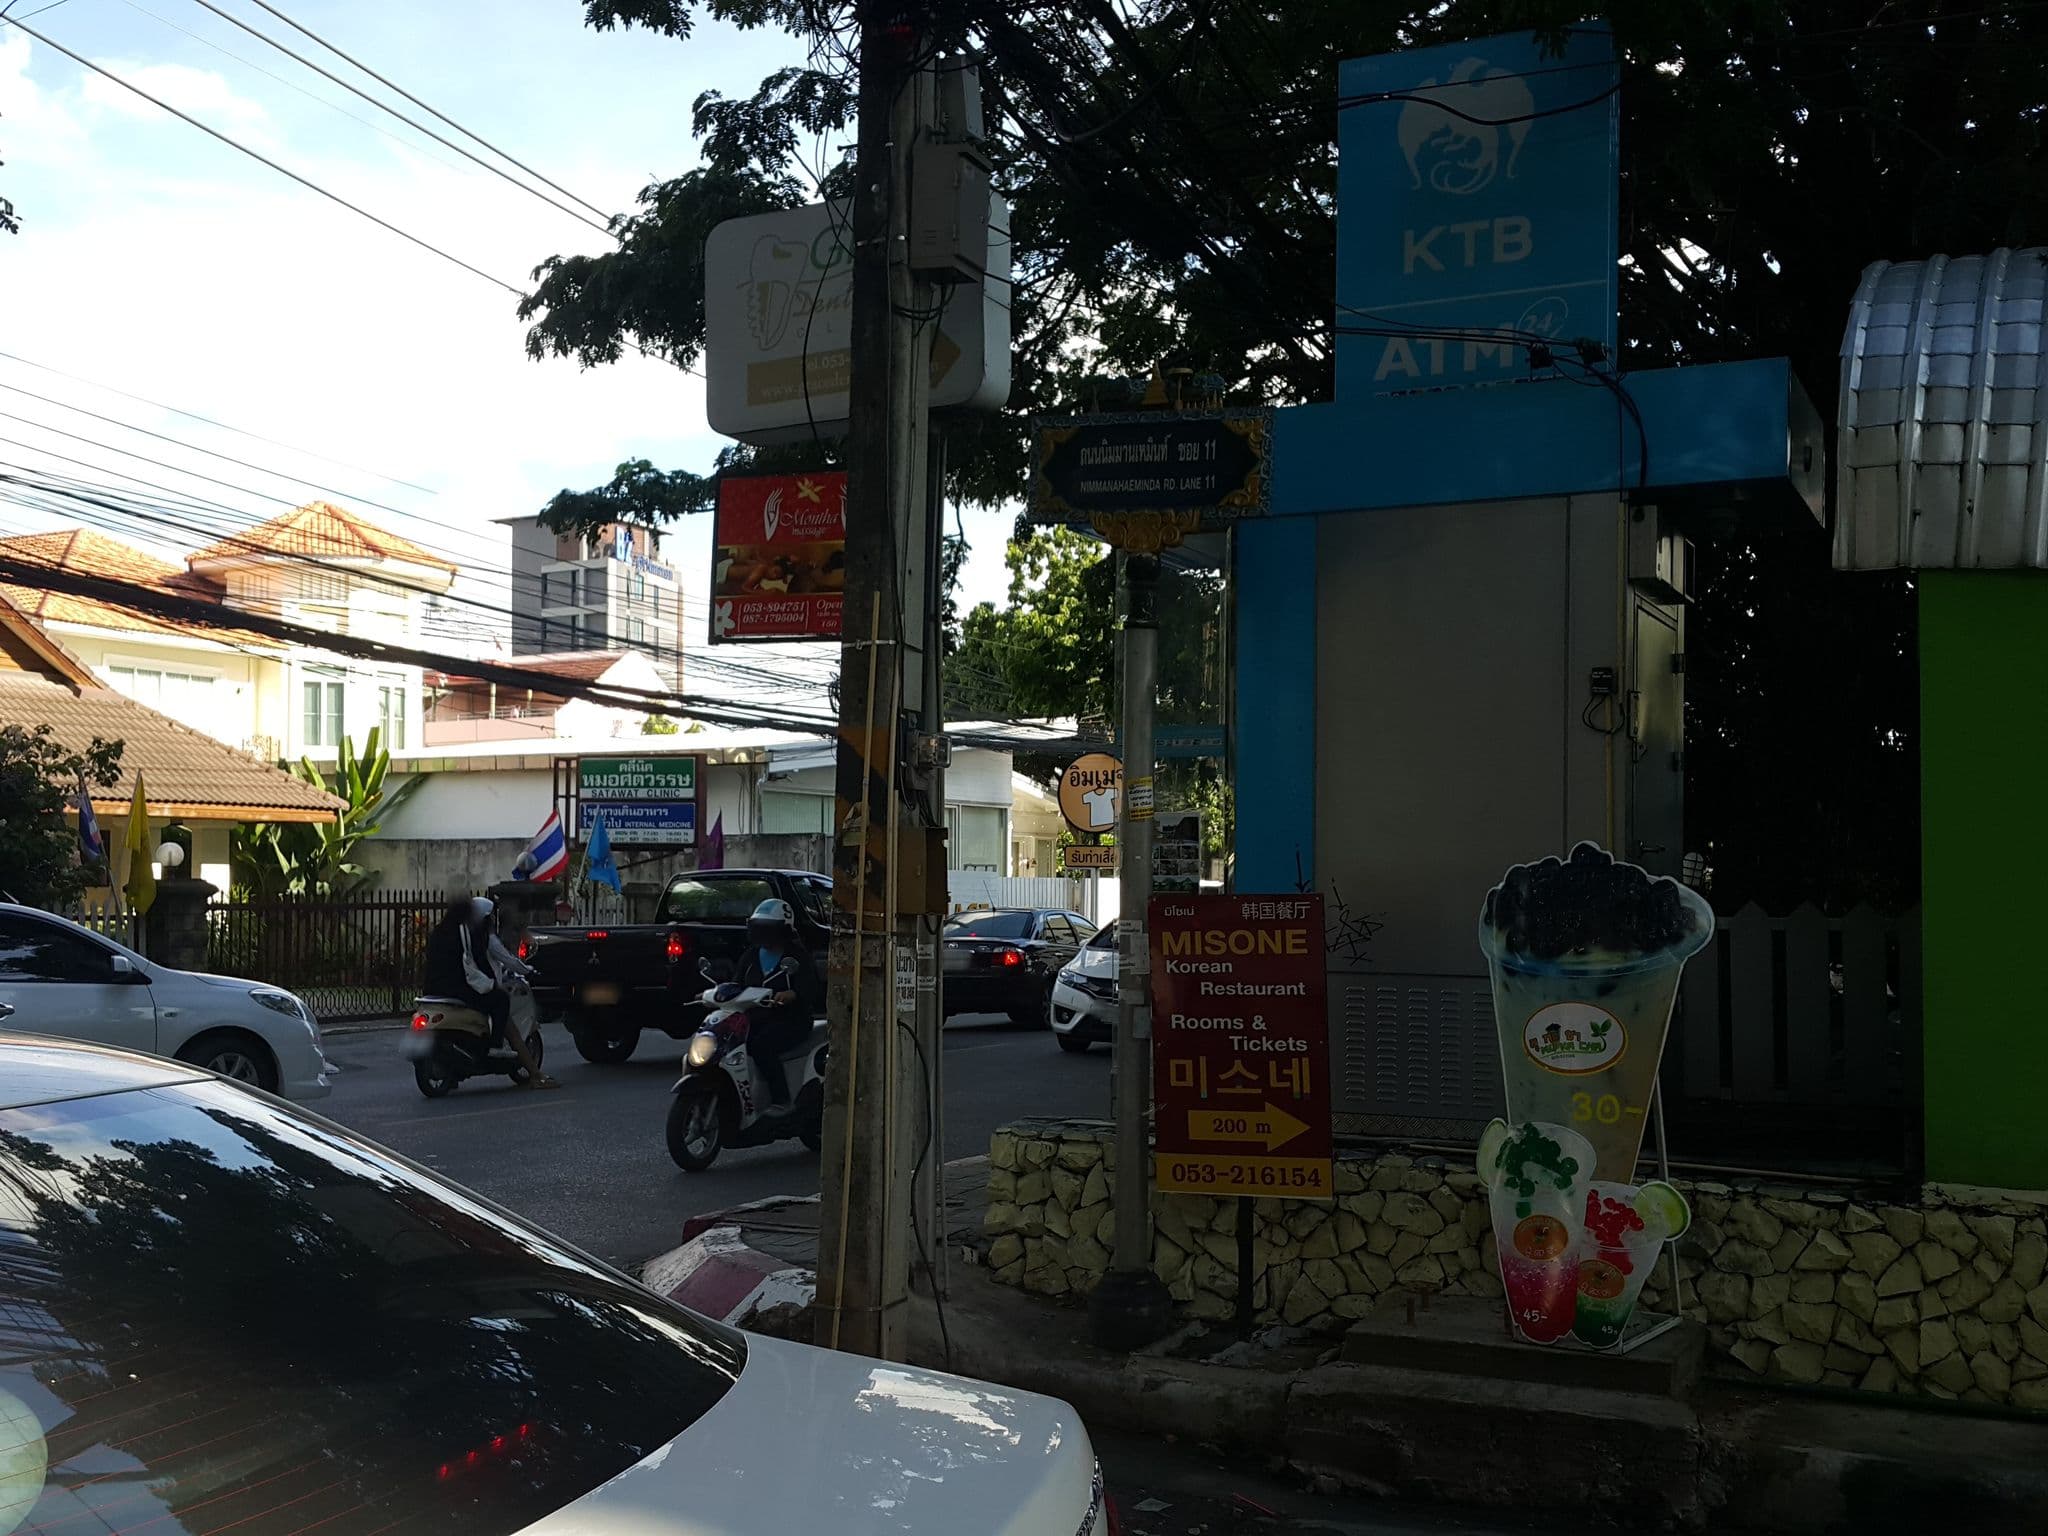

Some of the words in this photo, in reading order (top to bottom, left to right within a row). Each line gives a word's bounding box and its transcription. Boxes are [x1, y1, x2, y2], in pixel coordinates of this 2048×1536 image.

[1402, 215, 1533, 275] KTB
[1373, 321, 1514, 382] ATM
[1523, 311, 1553, 334] 24
[1178, 442, 1200, 462] ซอย
[1204, 440, 1217, 461] 11
[1180, 477, 1201, 491] LANE
[1205, 475, 1216, 489] 11
[582, 773, 692, 787] หมอศตวรรษ
[592, 789, 639, 798] SATAWAT
[647, 789, 681, 798] CLINIC
[1241, 901, 1311, 920] 韩国餐厅
[1161, 928, 1309, 957] MISONE
[1166, 959, 1233, 974] Korean
[1200, 981, 1306, 996] Restaurant
[1170, 1014, 1244, 1030] Rooms
[1252, 1014, 1267, 1031] &
[1229, 1035, 1308, 1052] Tickets
[1168, 1056, 1312, 1101] 미스네
[1213, 1118, 1247, 1134] 200
[1255, 1122, 1272, 1134] m
[1171, 1163, 1321, 1187] 053-216154
